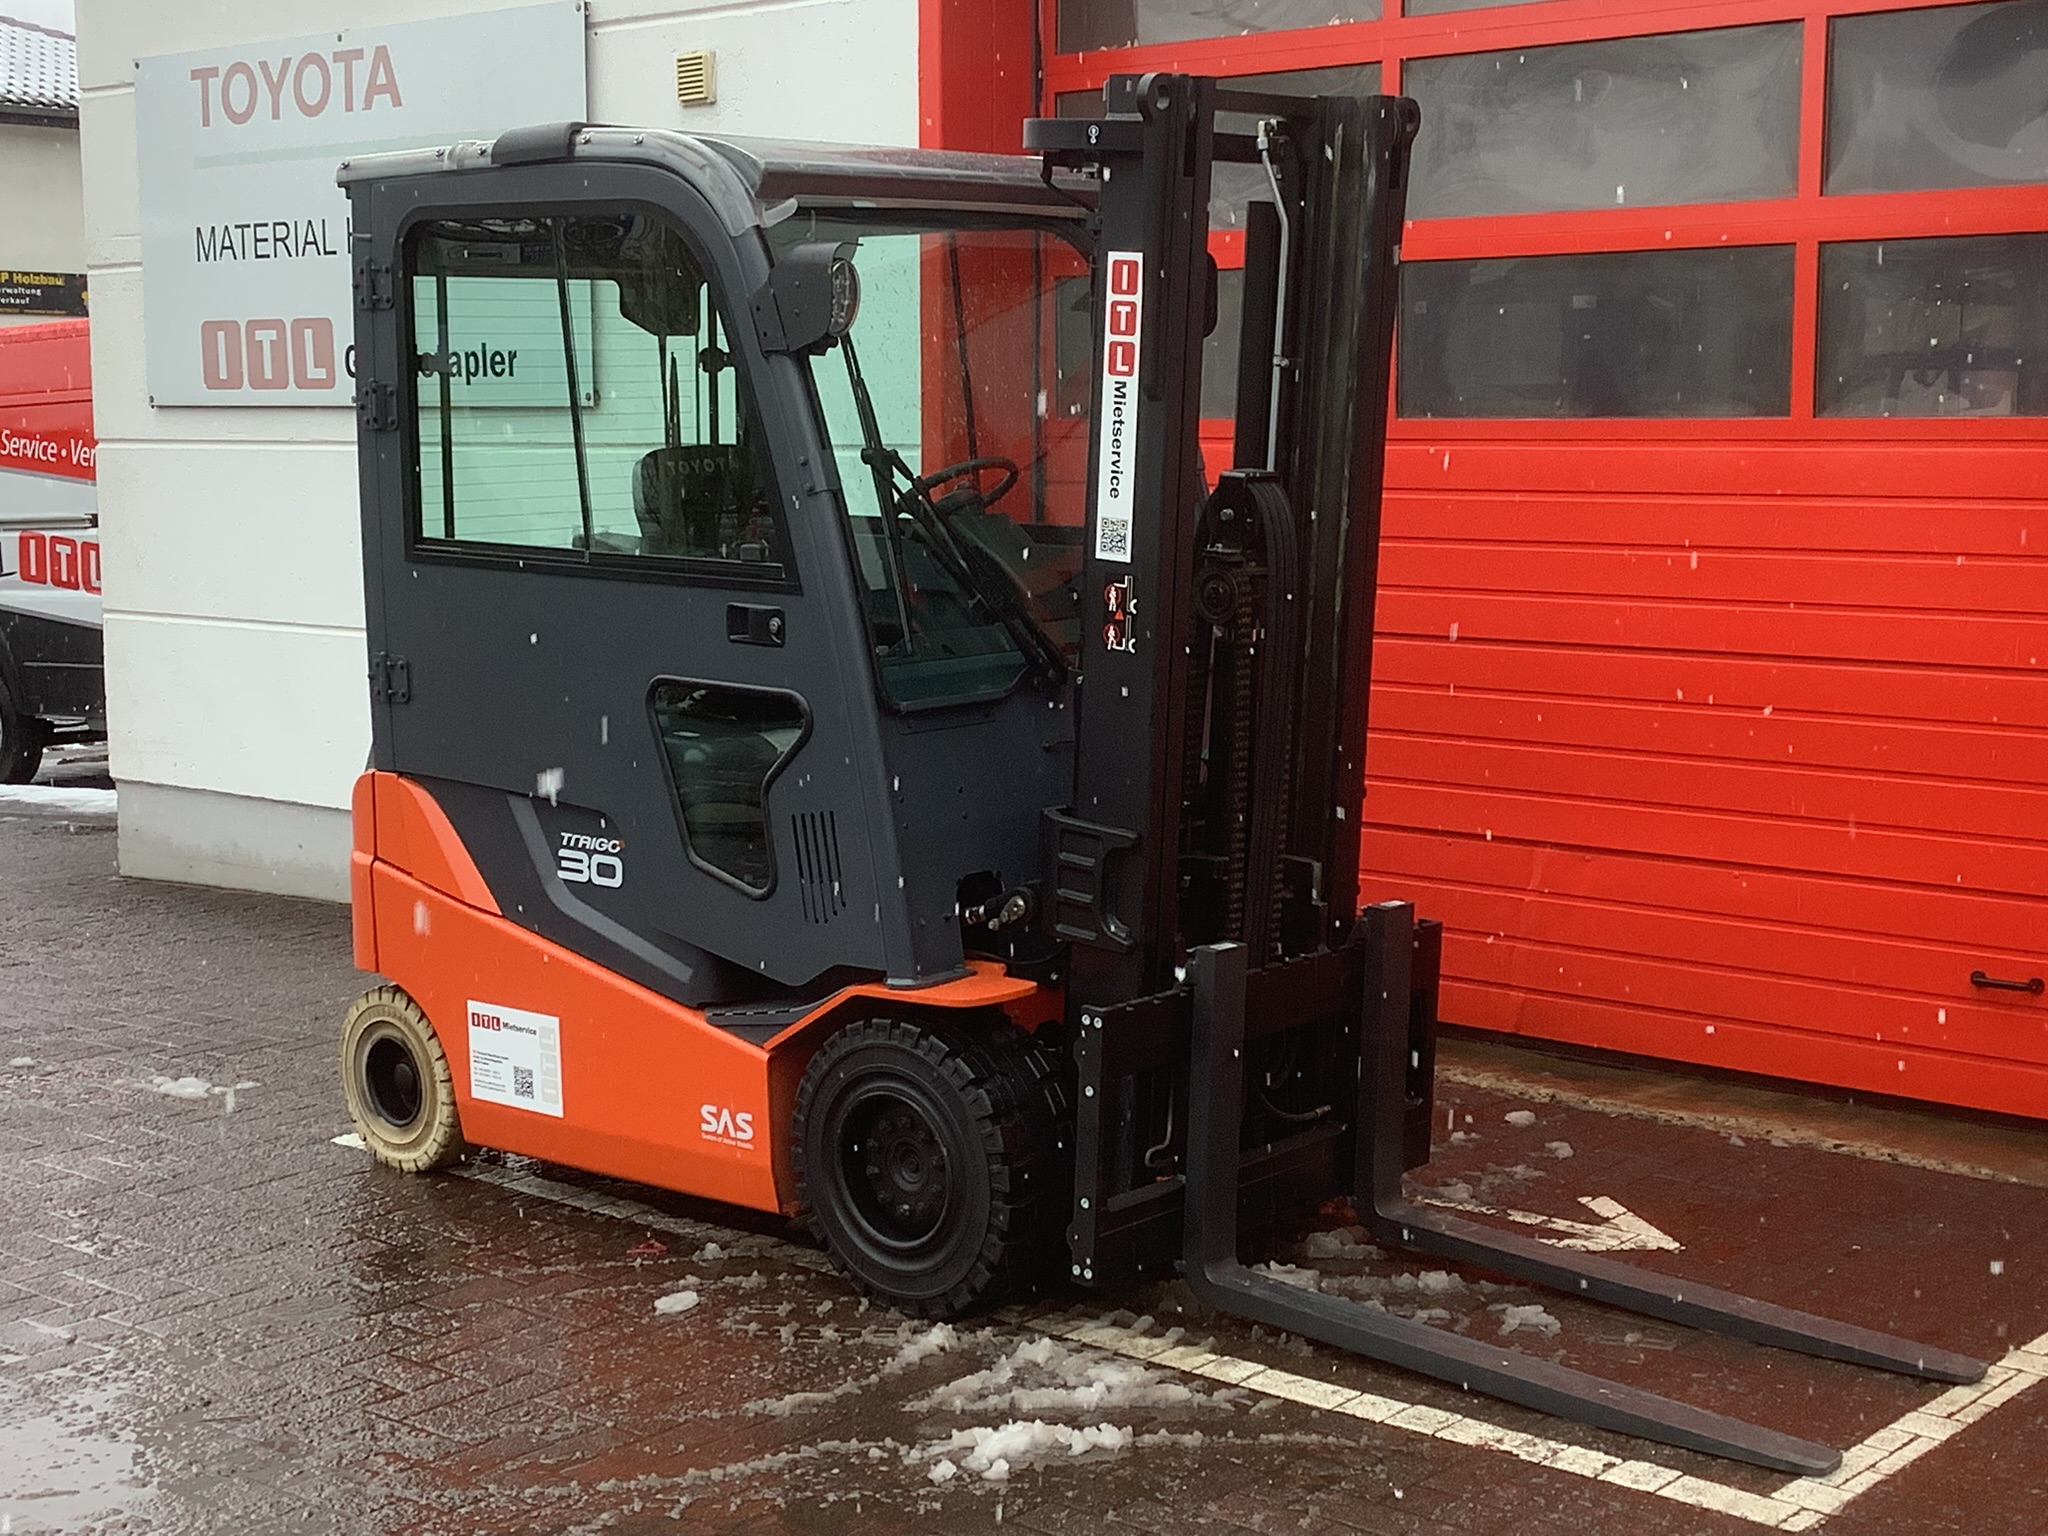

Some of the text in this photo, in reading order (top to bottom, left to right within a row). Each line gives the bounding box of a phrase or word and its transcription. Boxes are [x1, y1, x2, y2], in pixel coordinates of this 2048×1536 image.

[190, 45, 403, 128] TOYOTA
[196, 219, 337, 262] MATERIAL
[0, 287, 42, 296] rwaltung
[13, 272, 65, 286] Holzbau
[0, 296, 30, 304] erkauf
[209, 323, 331, 384] ITL
[1109, 262, 1135, 499] ITL Mietservice
[1, 429, 57, 462] Service
[557, 849, 623, 888] 30
[472, 1012, 500, 1031] ITL
[701, 1104, 754, 1141] SAS
